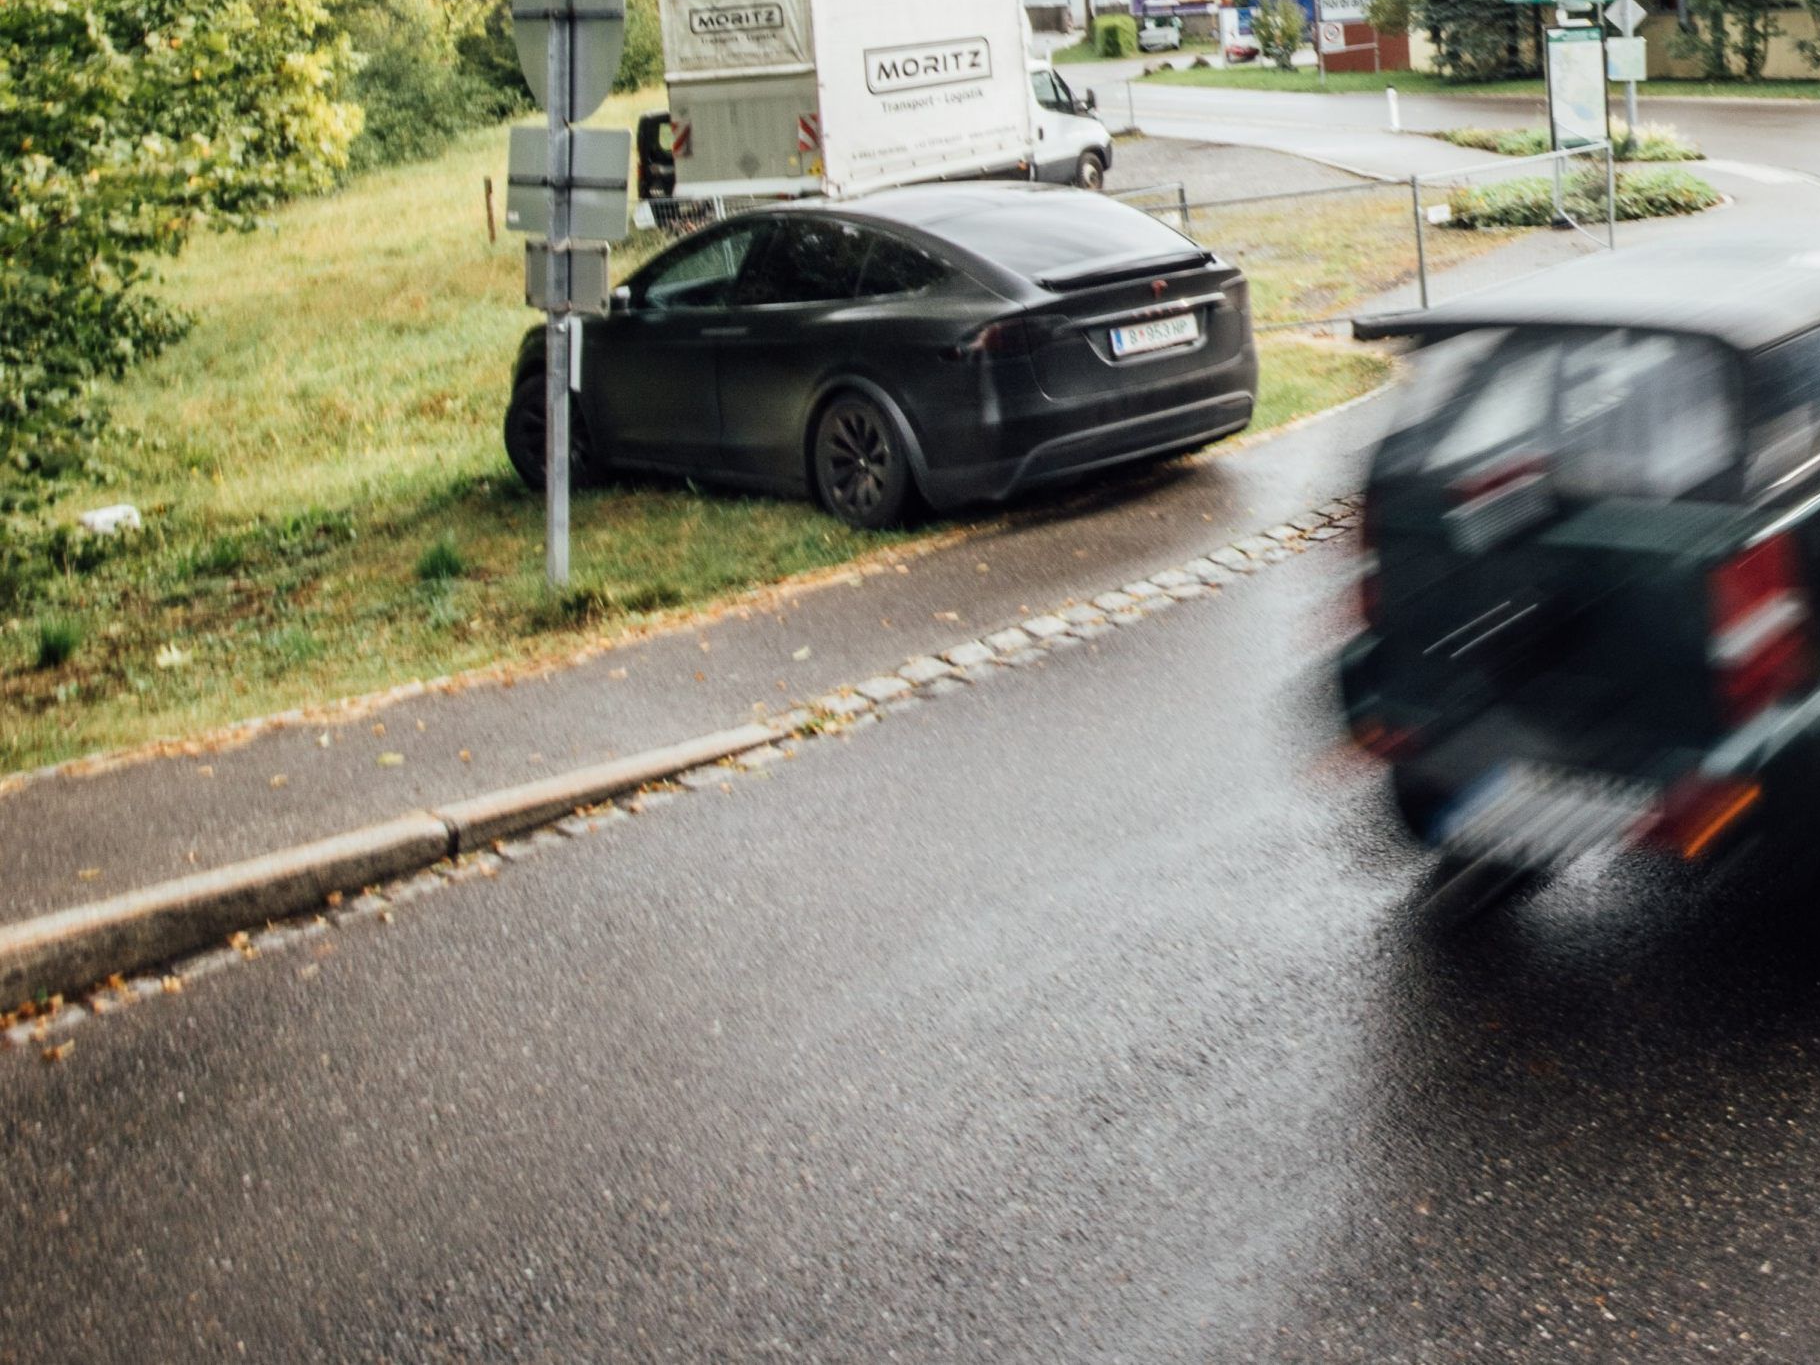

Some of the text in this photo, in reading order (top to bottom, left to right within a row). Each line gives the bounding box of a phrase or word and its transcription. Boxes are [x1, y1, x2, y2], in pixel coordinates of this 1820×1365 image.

[698, 10, 775, 29] MORITZ
[877, 50, 982, 81] MORITZ
[881, 94, 935, 114] Transport
[944, 87, 984, 106] Logistik
